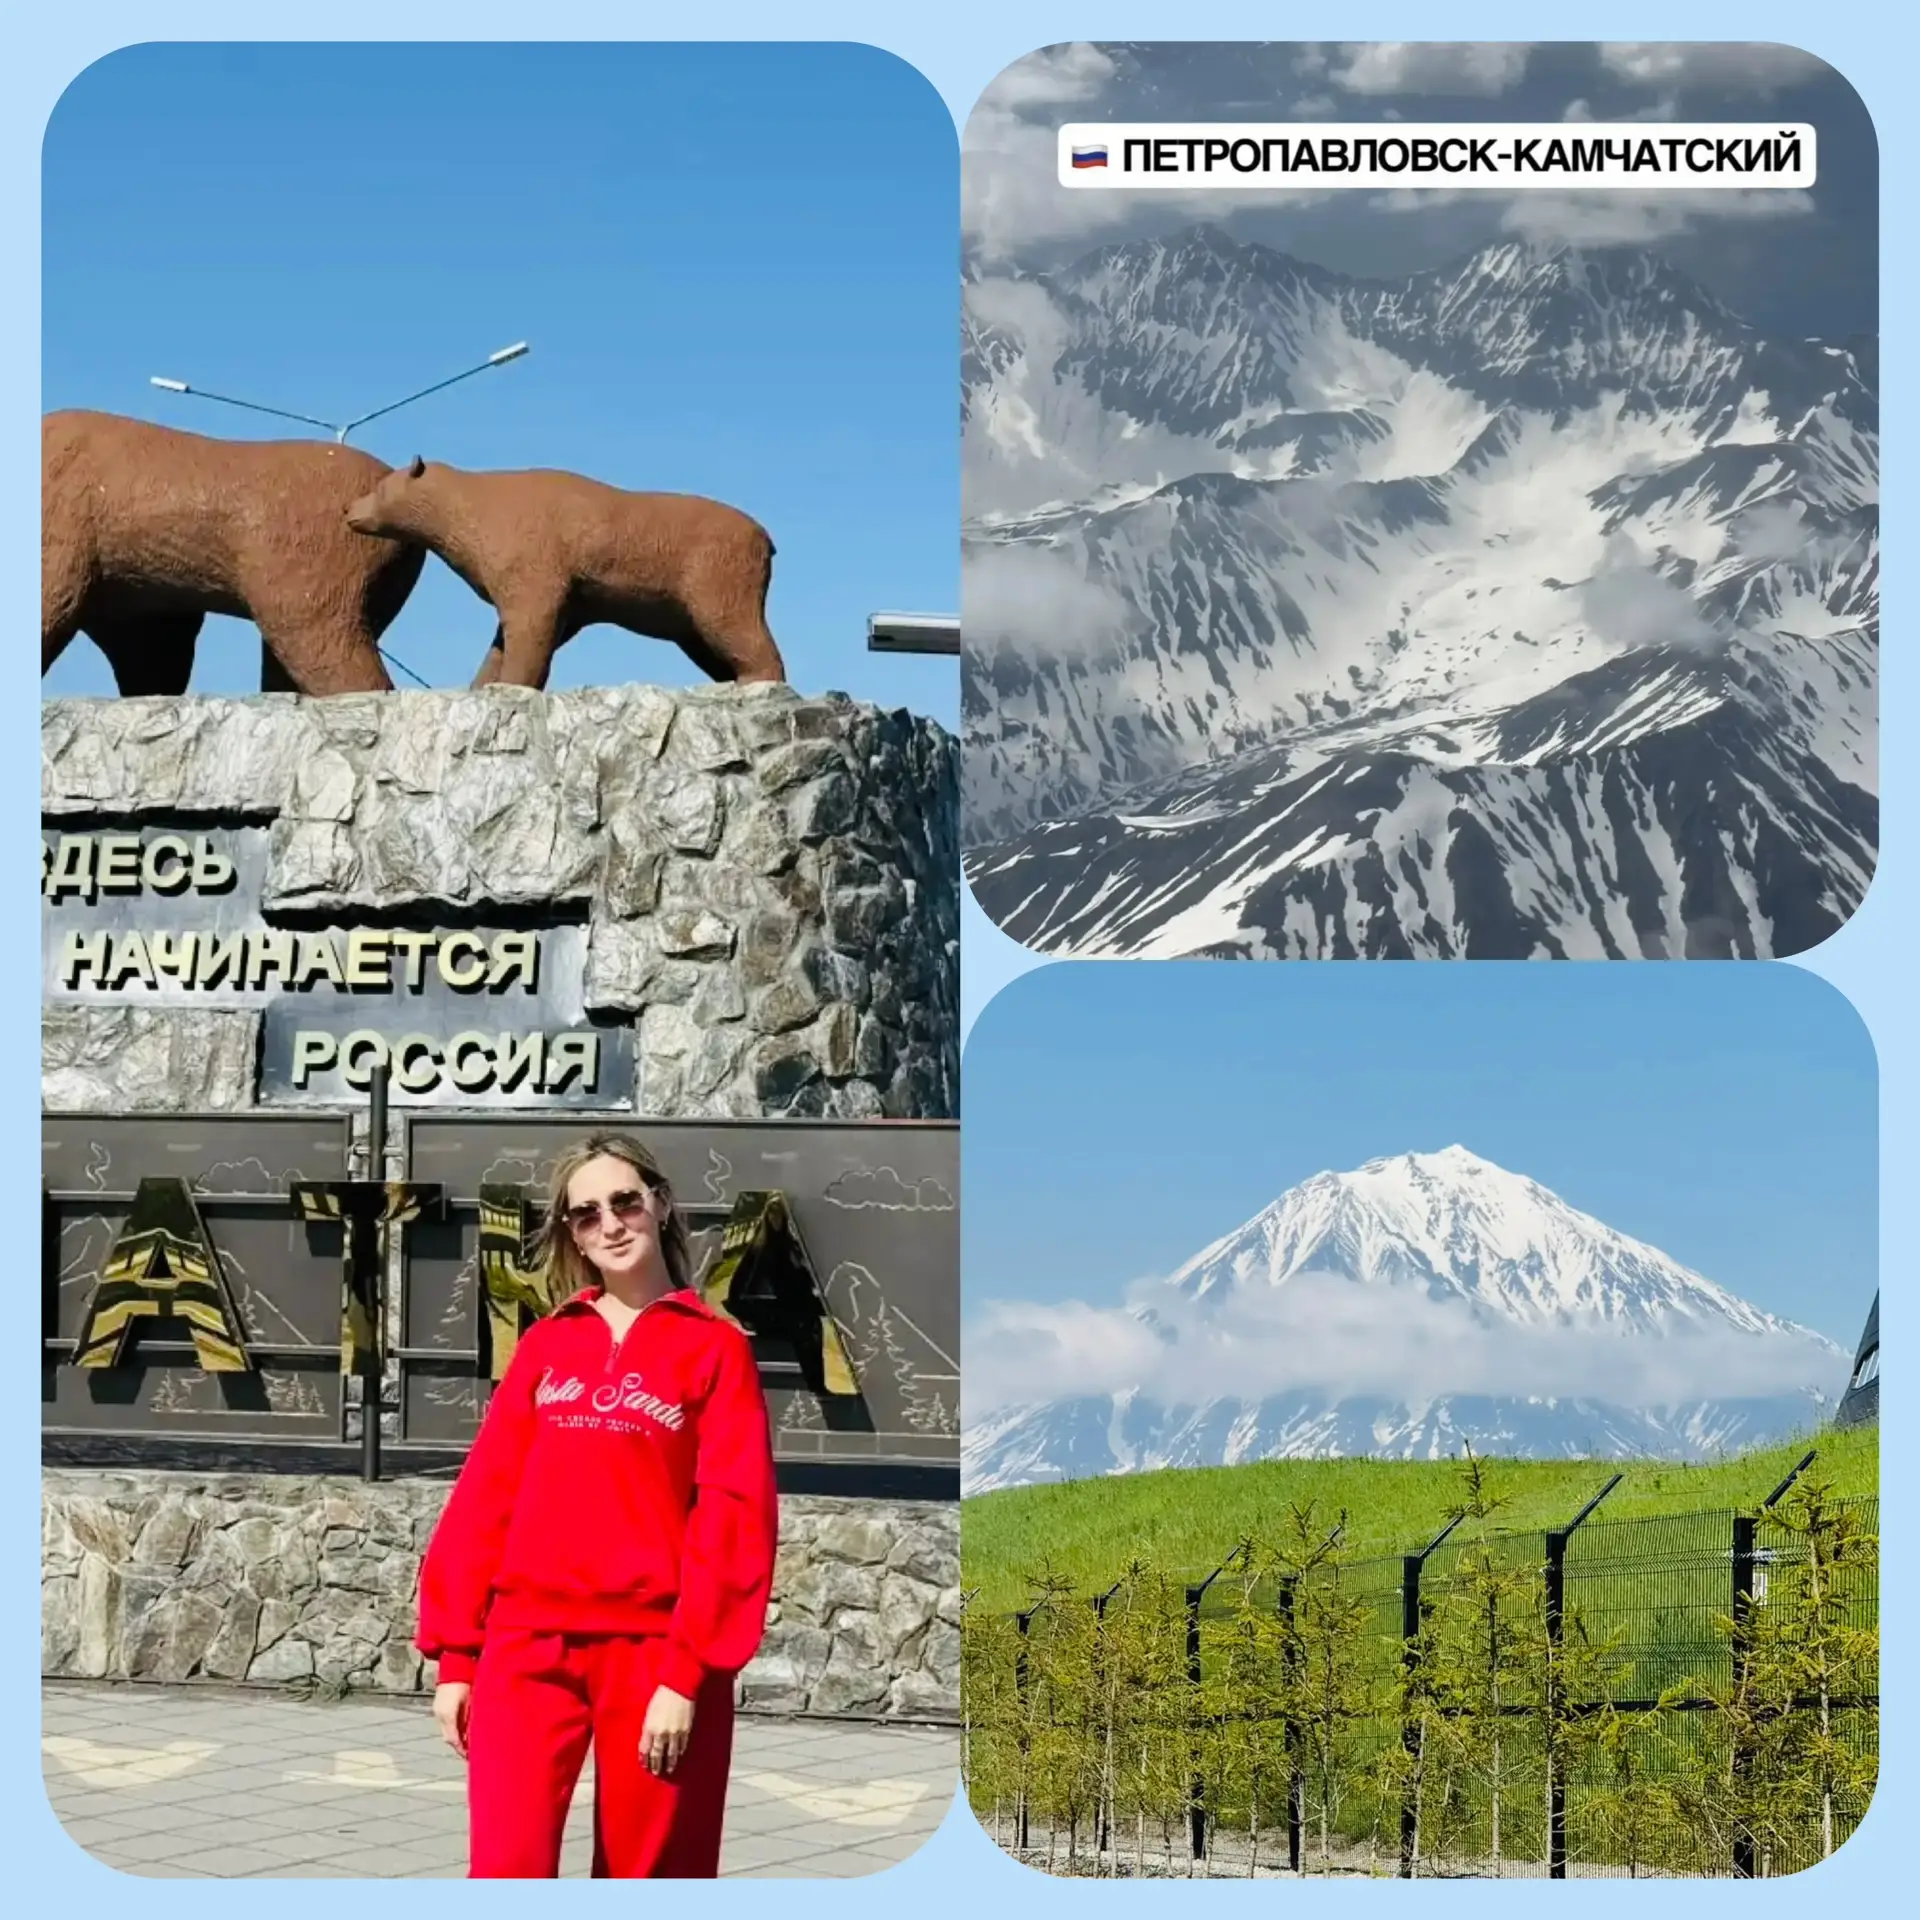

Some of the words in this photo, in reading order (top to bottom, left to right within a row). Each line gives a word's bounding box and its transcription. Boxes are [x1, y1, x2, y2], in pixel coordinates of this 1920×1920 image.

[41, 834, 233, 896] ДЕСЬ
[60, 930, 538, 988] НАЧИНАЕТСЯ
[291, 1029, 599, 1090] РОССИЯ
